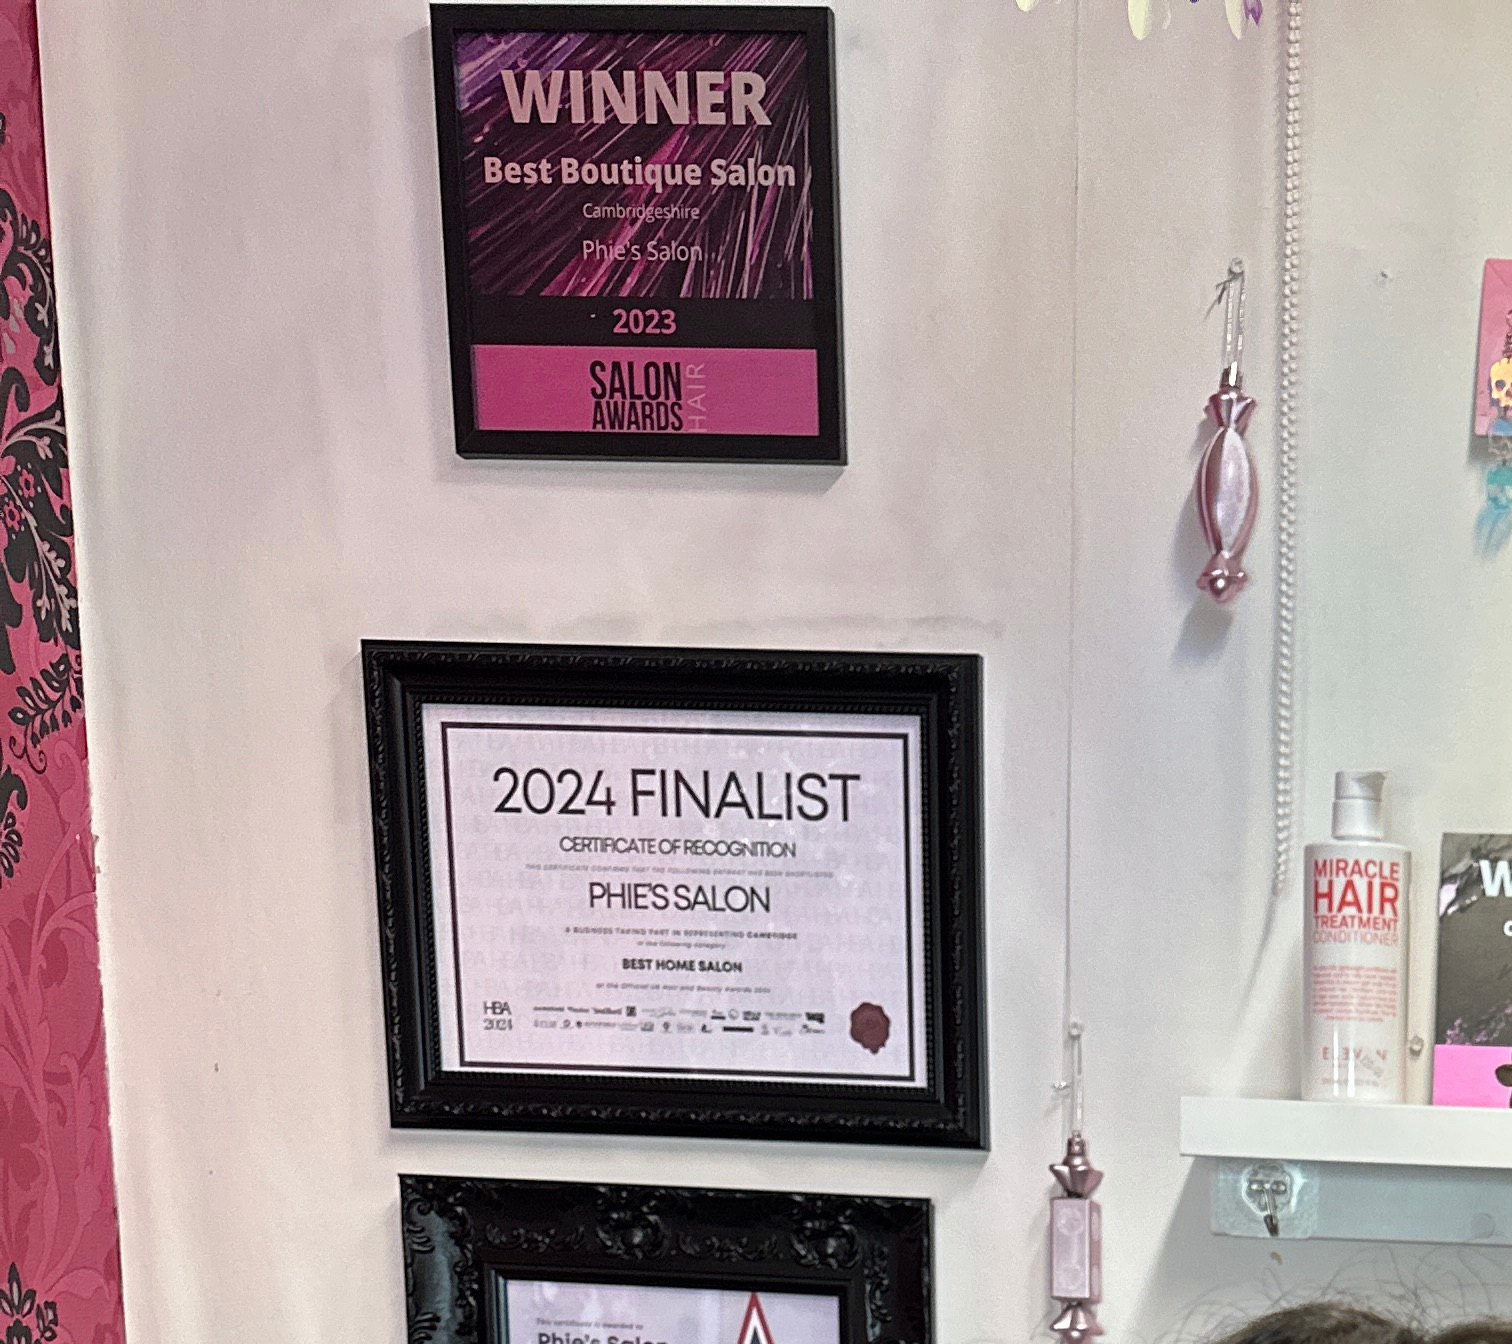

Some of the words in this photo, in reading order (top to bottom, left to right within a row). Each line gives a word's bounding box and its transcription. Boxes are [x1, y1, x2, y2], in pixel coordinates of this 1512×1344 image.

[500, 69, 772, 126] WINNER
[483, 155, 552, 185] Best
[561, 156, 702, 193] Boutique
[711, 158, 796, 187] Salon
[582, 203, 701, 223] Cambridgeshire
[582, 240, 641, 261] Phie's
[647, 240, 702, 262] Salon
[612, 308, 677, 335] 2023
[589, 360, 682, 401] SALON
[686, 362, 707, 433] HAIR
[591, 401, 684, 431] AWARDS
[491, 767, 616, 816] 2024
[631, 768, 860, 823] FINALIST
[558, 835, 656, 855] CERTIFICATE
[658, 838, 683, 855] OF
[684, 839, 797, 858] RECOGNITION
[1313, 858, 1400, 881] MIRACLE
[589, 881, 669, 911] PHIE'S
[673, 885, 771, 914] SALON
[1314, 879, 1399, 917] HAIR
[1314, 915, 1398, 932] TREATMENT
[622, 958, 651, 971] BEST
[656, 959, 695, 972] HOME
[698, 961, 743, 974] SALON
